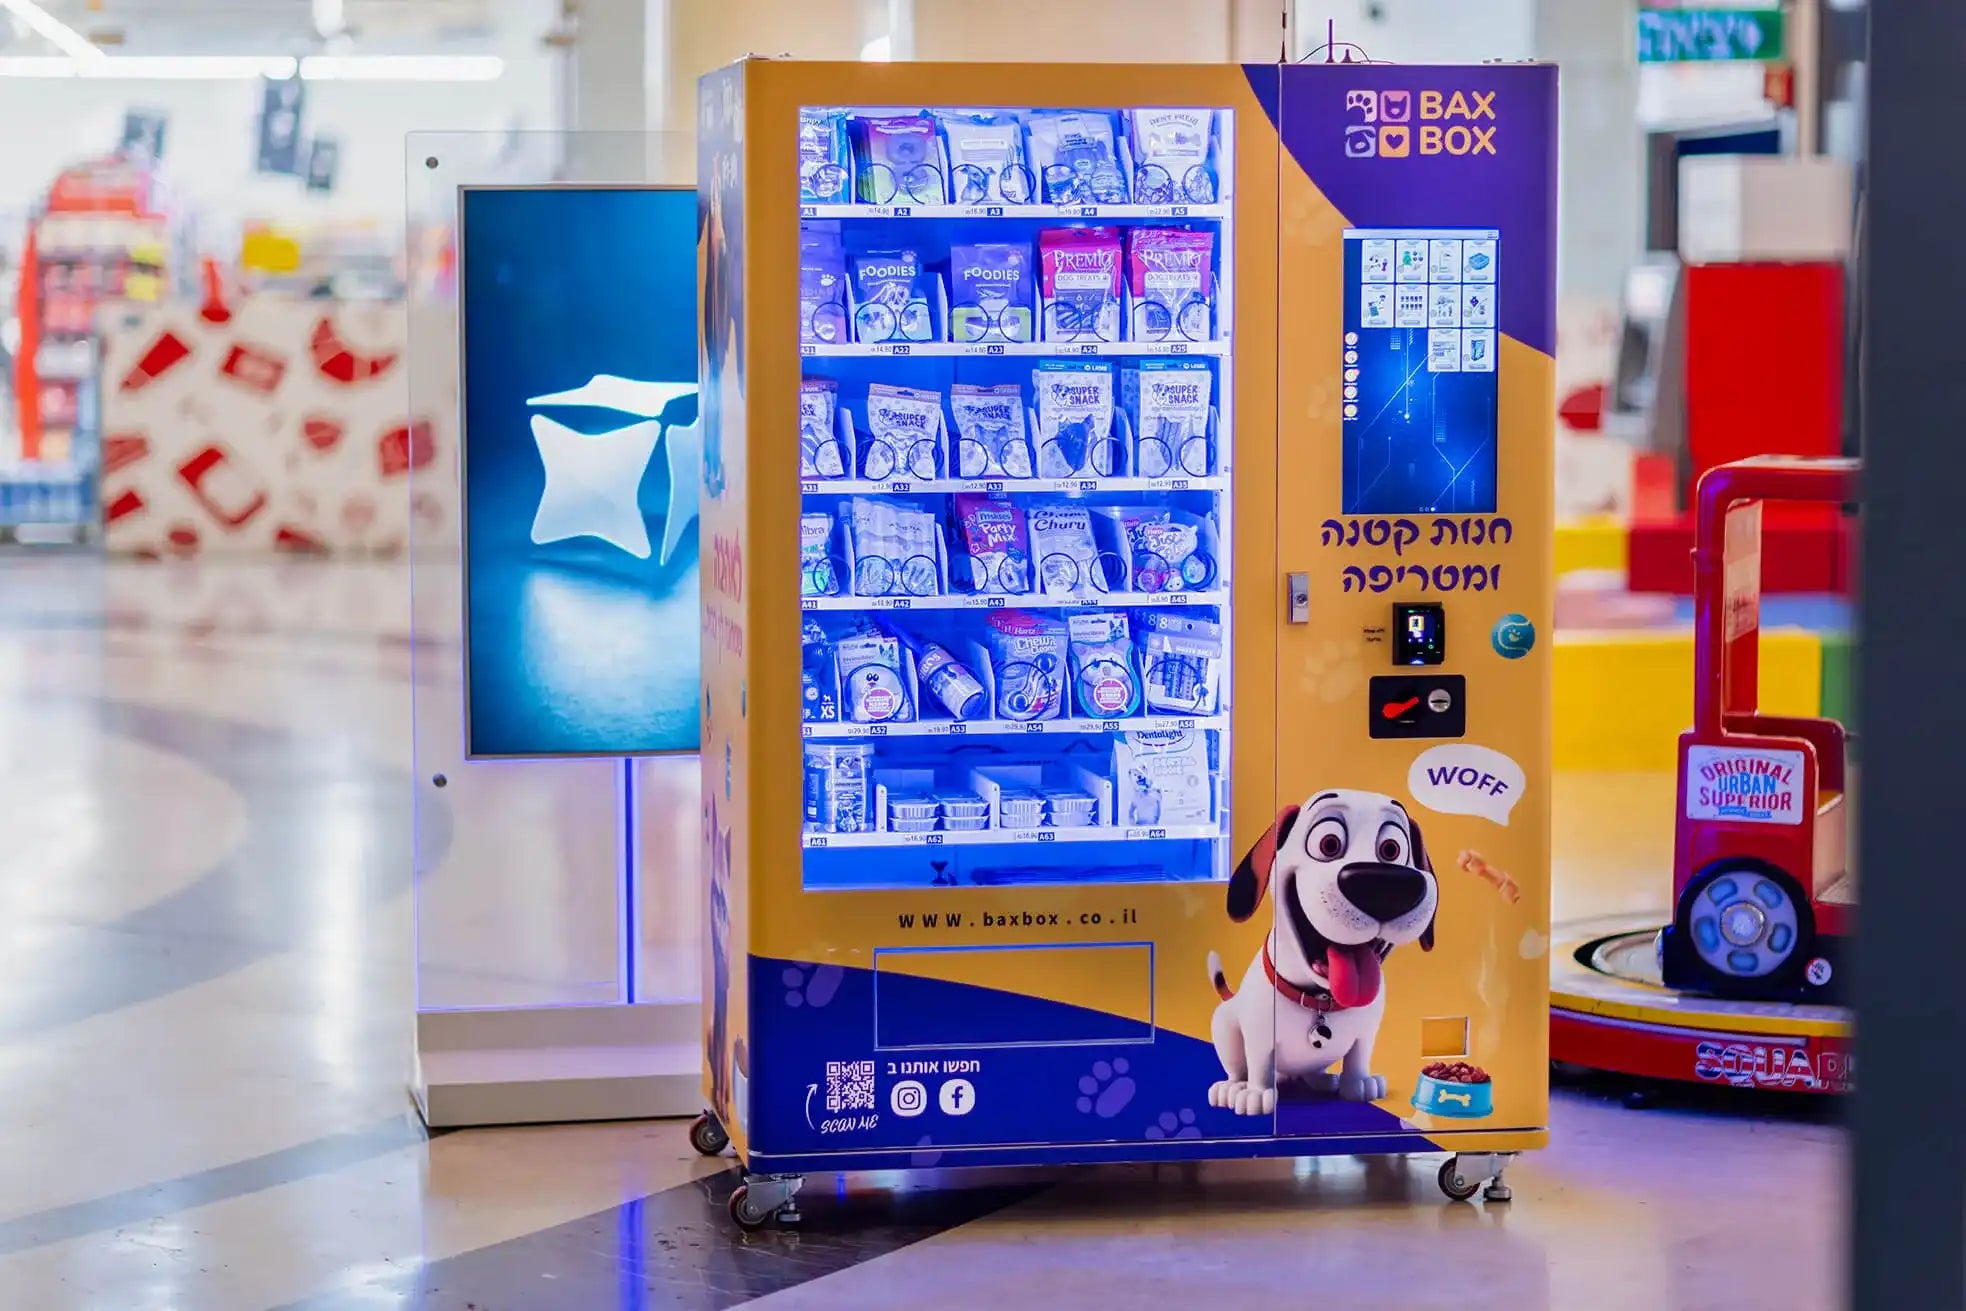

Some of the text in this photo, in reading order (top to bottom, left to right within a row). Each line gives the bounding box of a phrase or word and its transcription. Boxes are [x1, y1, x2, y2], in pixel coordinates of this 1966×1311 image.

[1419, 90, 1496, 120] BAX
[1419, 125, 1497, 155] BOX
[896, 208, 909, 216] A2
[989, 208, 1001, 216] A3
[1083, 208, 1096, 216] A4
[1173, 207, 1186, 215] A5
[859, 265, 916, 281] FOODIES
[964, 266, 1020, 281] FOODIES
[1071, 385, 1099, 395] SUPER
[1170, 384, 1199, 394] SUPER
[1069, 394, 1100, 405] SNACK
[1168, 394, 1200, 404] SNACK
[894, 483, 909, 491] A32
[1081, 482, 1096, 490] A34
[979, 522, 1016, 537] Party
[1034, 518, 1086, 531] Churu
[987, 533, 1015, 547] Mix
[1321, 517, 1512, 556] חנות קטנה
[1342, 564, 1500, 593] ומטריפה
[894, 600, 909, 608] A42
[1159, 616, 1169, 629] 8
[820, 705, 834, 718] XS
[951, 725, 965, 733] A53
[1028, 723, 1042, 731] A54
[1104, 722, 1118, 730] A55
[1180, 720, 1193, 728] A56
[872, 726, 886, 735] A52
[1700, 759, 1792, 785] ORIGINAL
[1427, 766, 1508, 796] WOFF
[1718, 772, 1776, 795] URBAN
[1699, 787, 1791, 811] SUPERIOR
[928, 835, 942, 843] A62
[1039, 832, 1054, 840] A63
[1151, 830, 1165, 838] A64
[812, 838, 826, 846] A61
[887, 1060, 980, 1074] חפשו אותנו ב
[820, 1114, 879, 1134] SCAN ME
